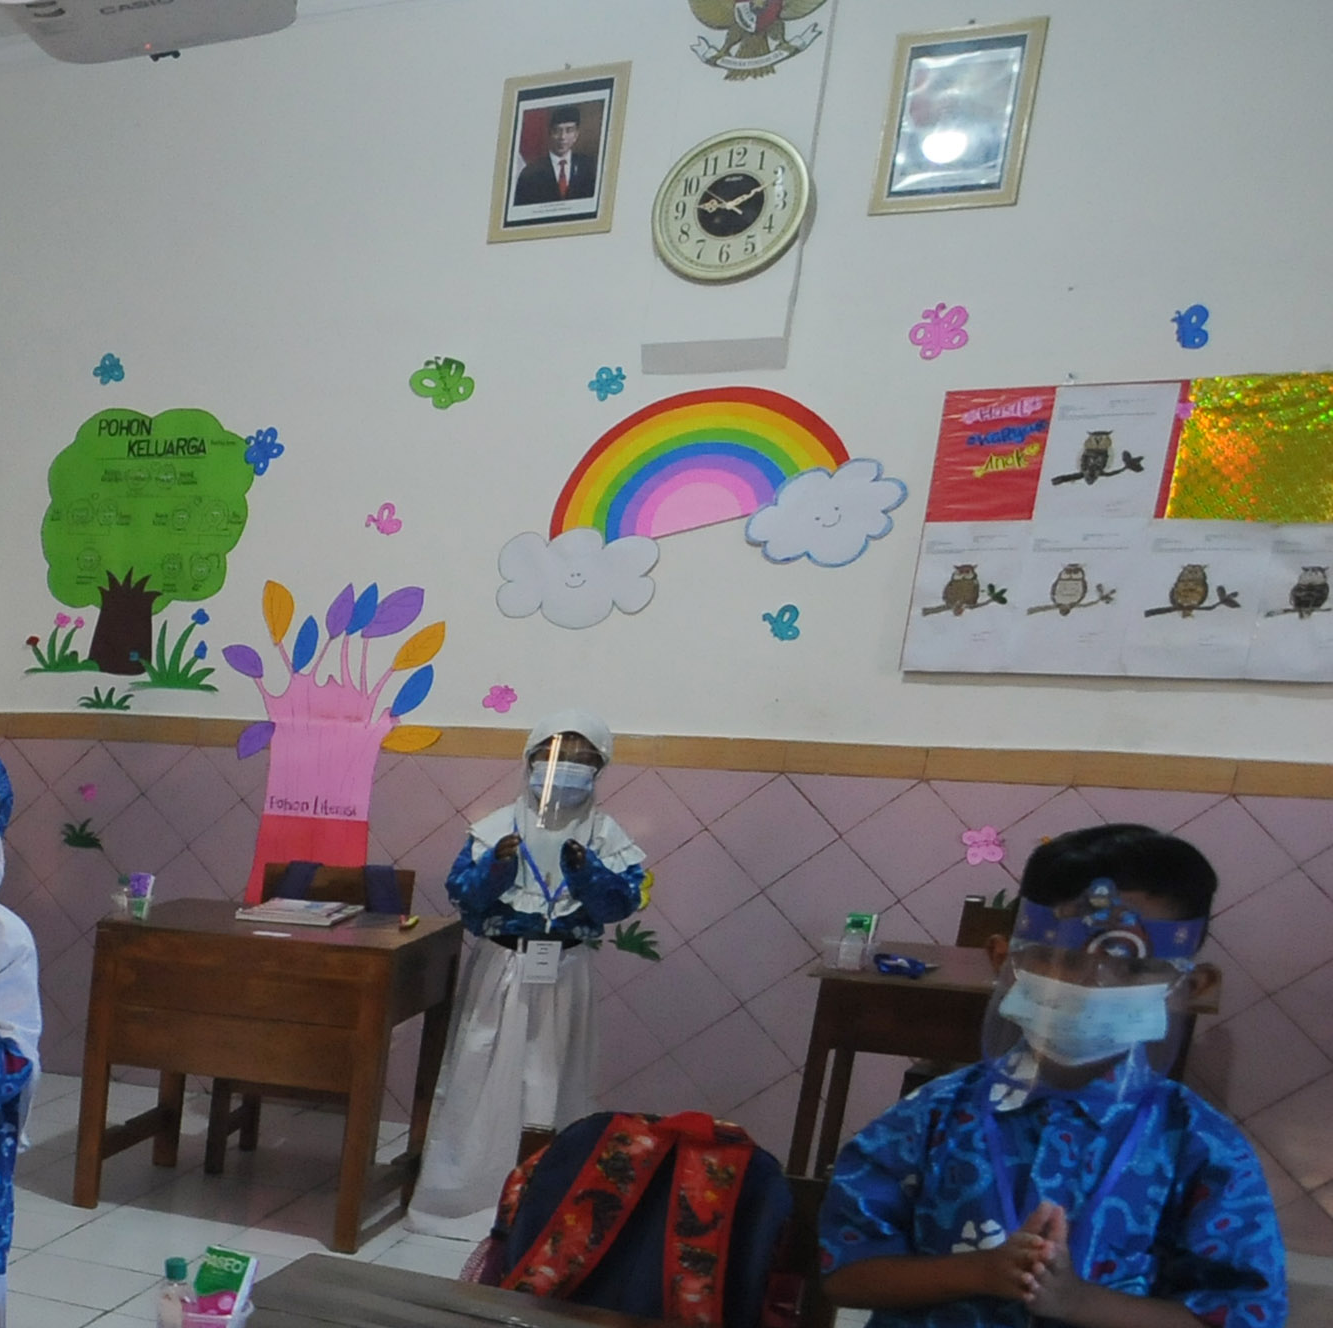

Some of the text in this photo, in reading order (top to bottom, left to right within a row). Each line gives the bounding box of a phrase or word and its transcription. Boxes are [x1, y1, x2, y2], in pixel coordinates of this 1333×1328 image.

[702, 155, 719, 177] 11
[727, 146, 748, 169] 12
[758, 150, 766, 171] 1
[683, 175, 701, 197] 10
[674, 201, 687, 220] 9
[678, 222, 691, 244] 8
[763, 213, 774, 234] 4
[695, 239, 706, 260] 7
[718, 243, 731, 264] 6
[744, 234, 756, 255] 5
[97, 418, 153, 438] POHON
[126, 437, 208, 459] KELUARGA
